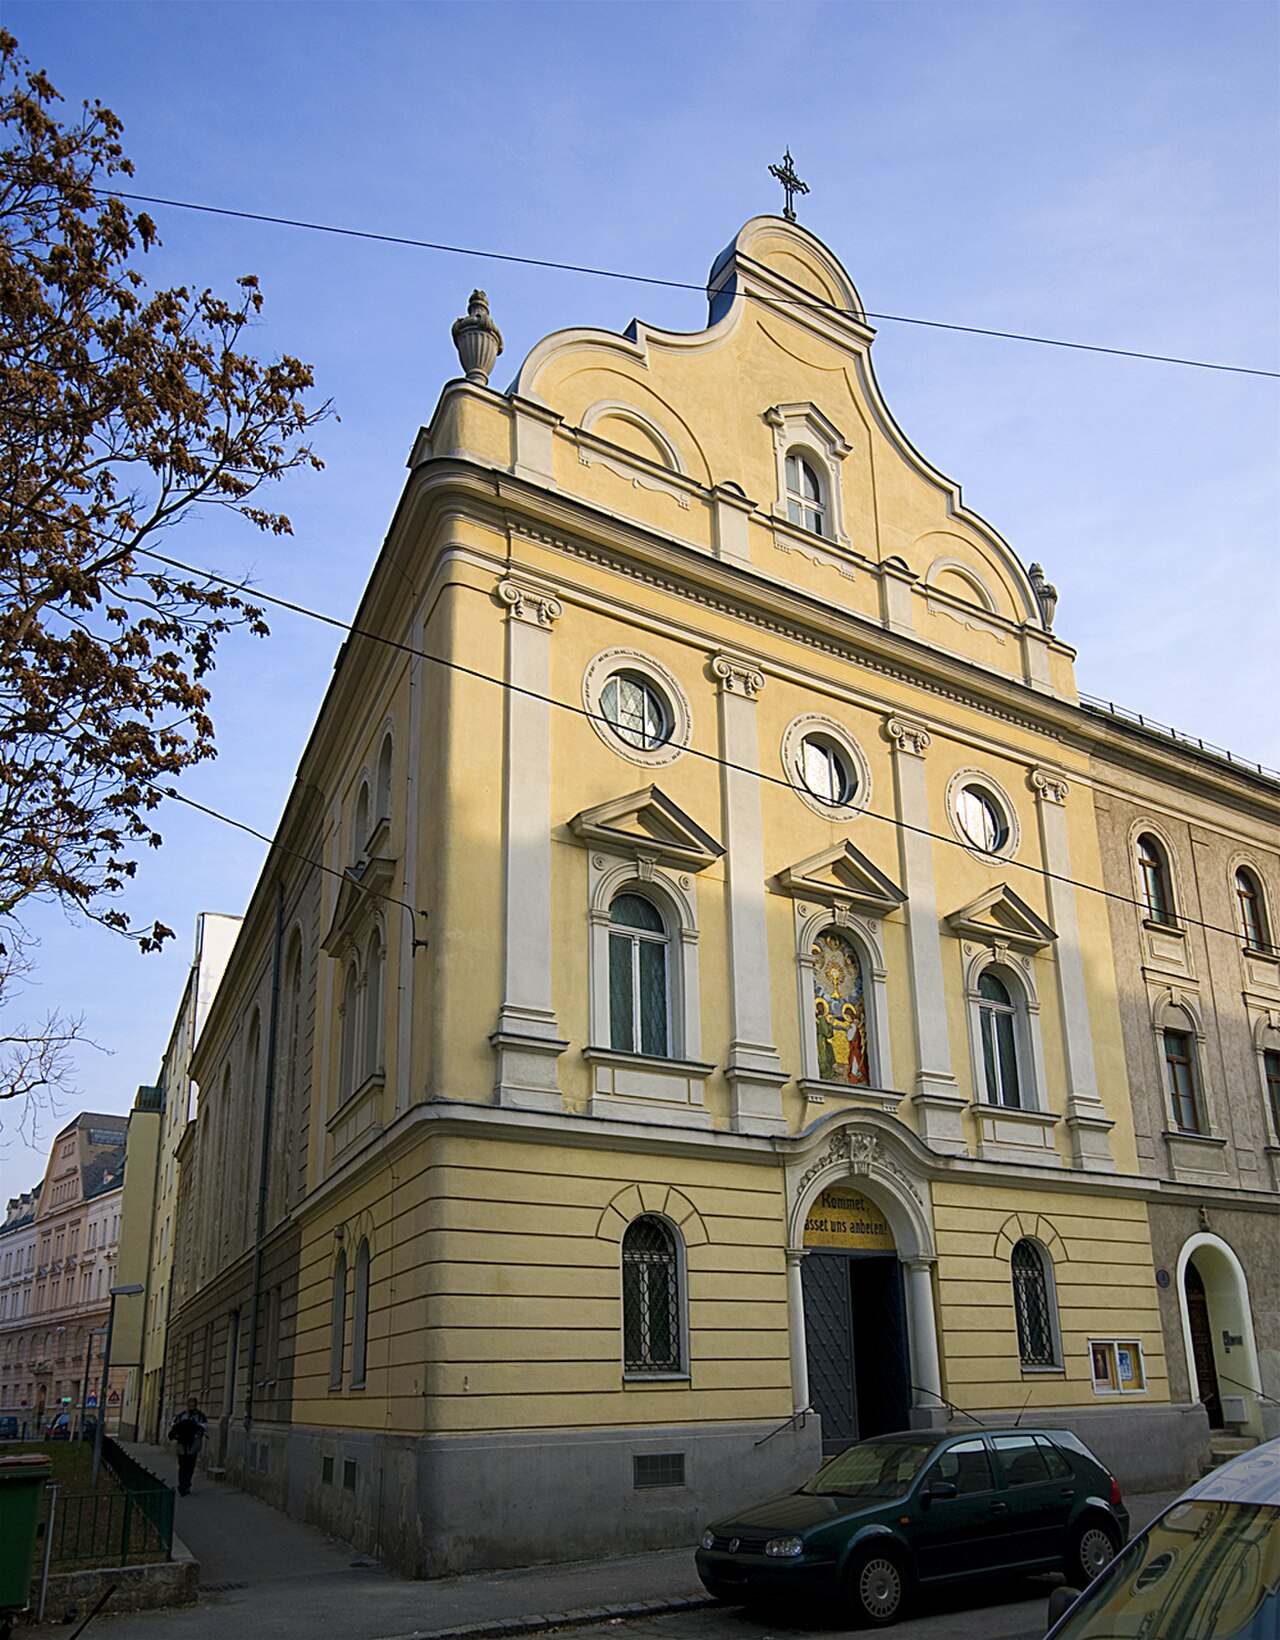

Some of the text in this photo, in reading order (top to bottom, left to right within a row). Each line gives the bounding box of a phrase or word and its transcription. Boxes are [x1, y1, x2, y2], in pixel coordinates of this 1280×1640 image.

[804, 1218, 887, 1236] asset uns anbeten!
